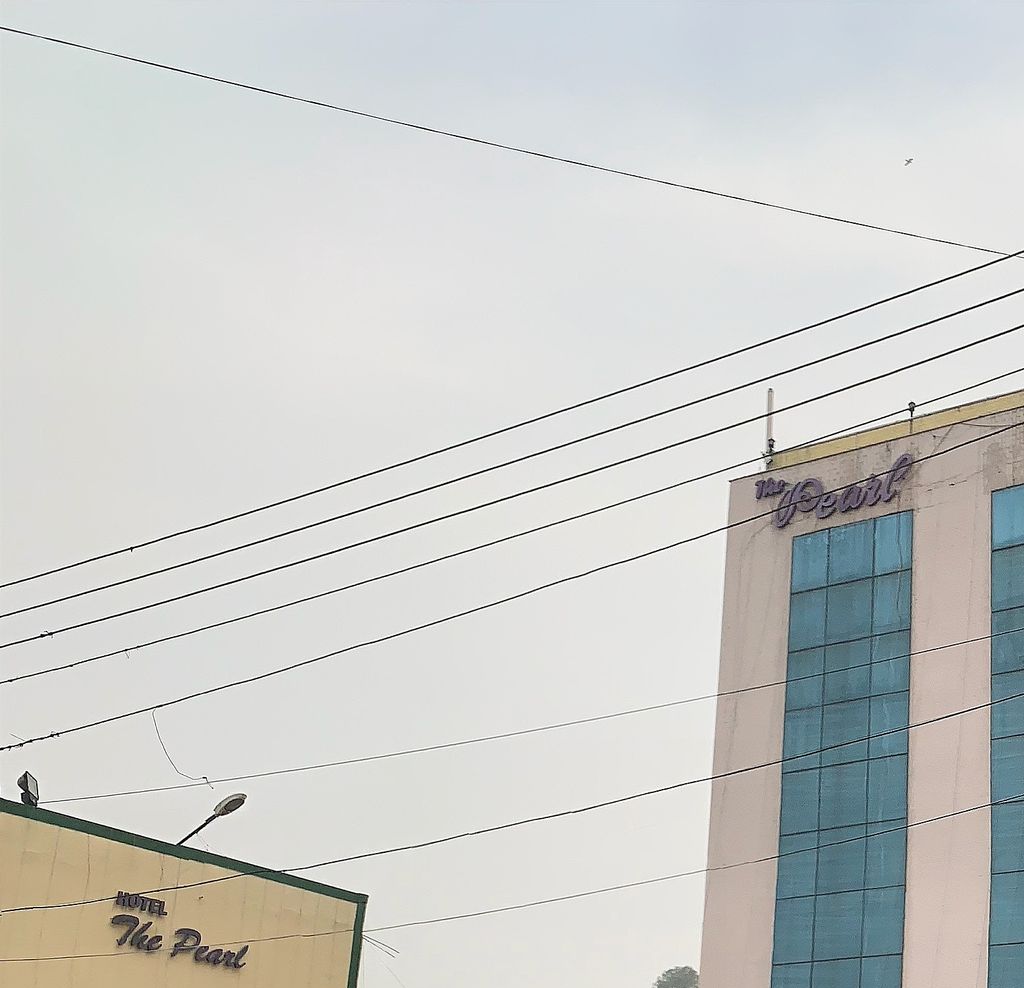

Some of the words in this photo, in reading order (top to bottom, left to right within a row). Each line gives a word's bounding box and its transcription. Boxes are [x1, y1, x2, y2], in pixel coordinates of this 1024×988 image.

[755, 477, 786, 499] The
[772, 453, 914, 528] Pearl
[115, 891, 168, 916] HOTEL
[111, 914, 163, 951] The
[171, 928, 249, 969] Pearl
